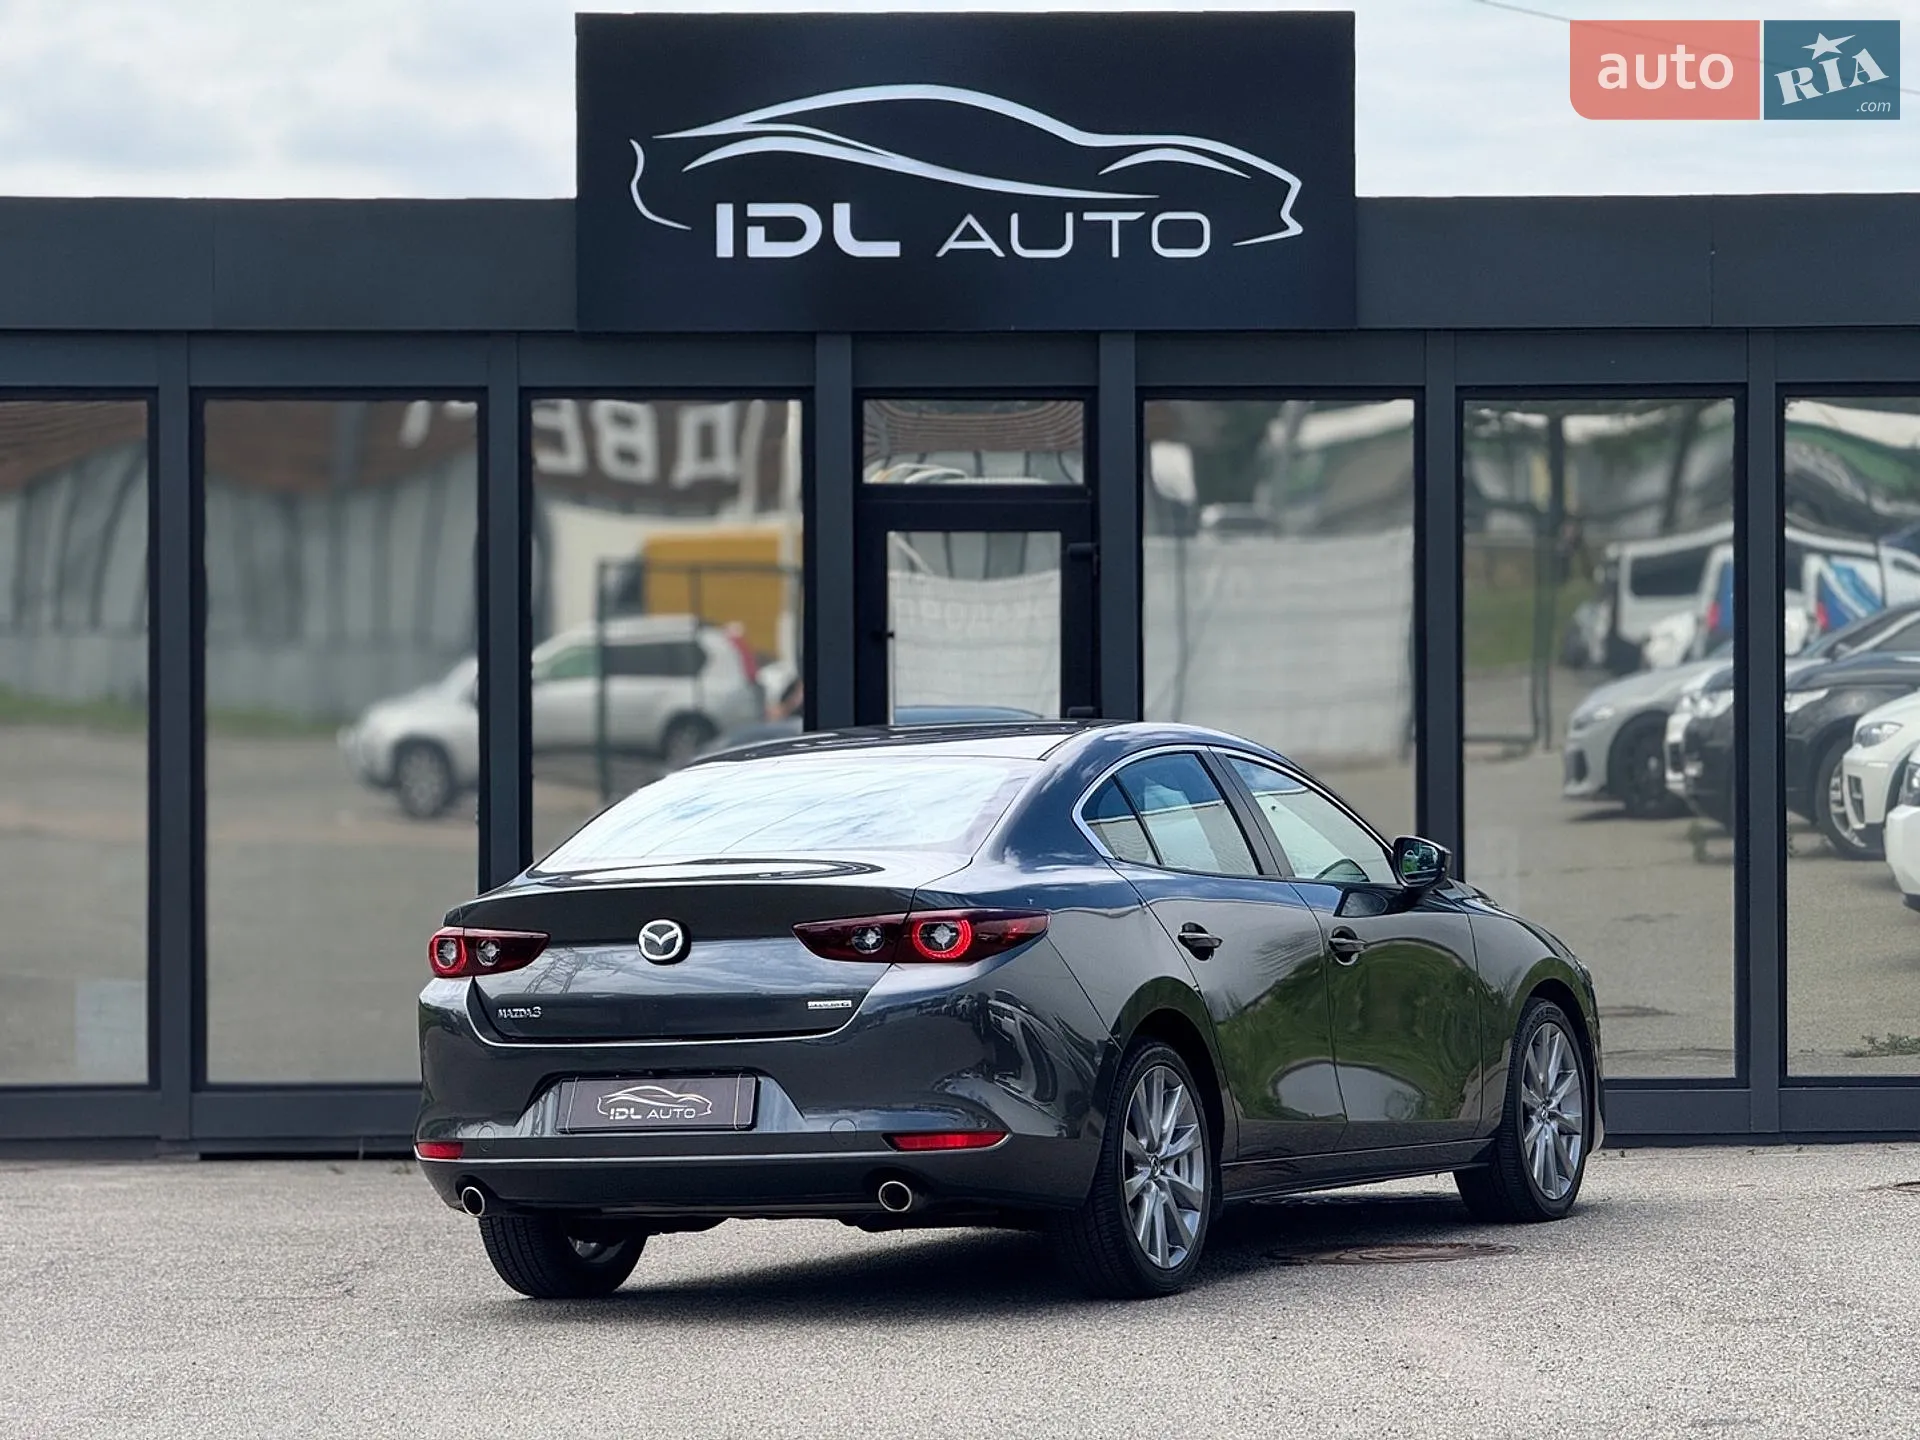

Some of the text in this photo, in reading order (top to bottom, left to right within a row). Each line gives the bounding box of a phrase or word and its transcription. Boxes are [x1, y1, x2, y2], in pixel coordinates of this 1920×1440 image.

[716, 203, 1210, 258] IDL AUTO
[609, 1108, 695, 1119] IDL AUTO
